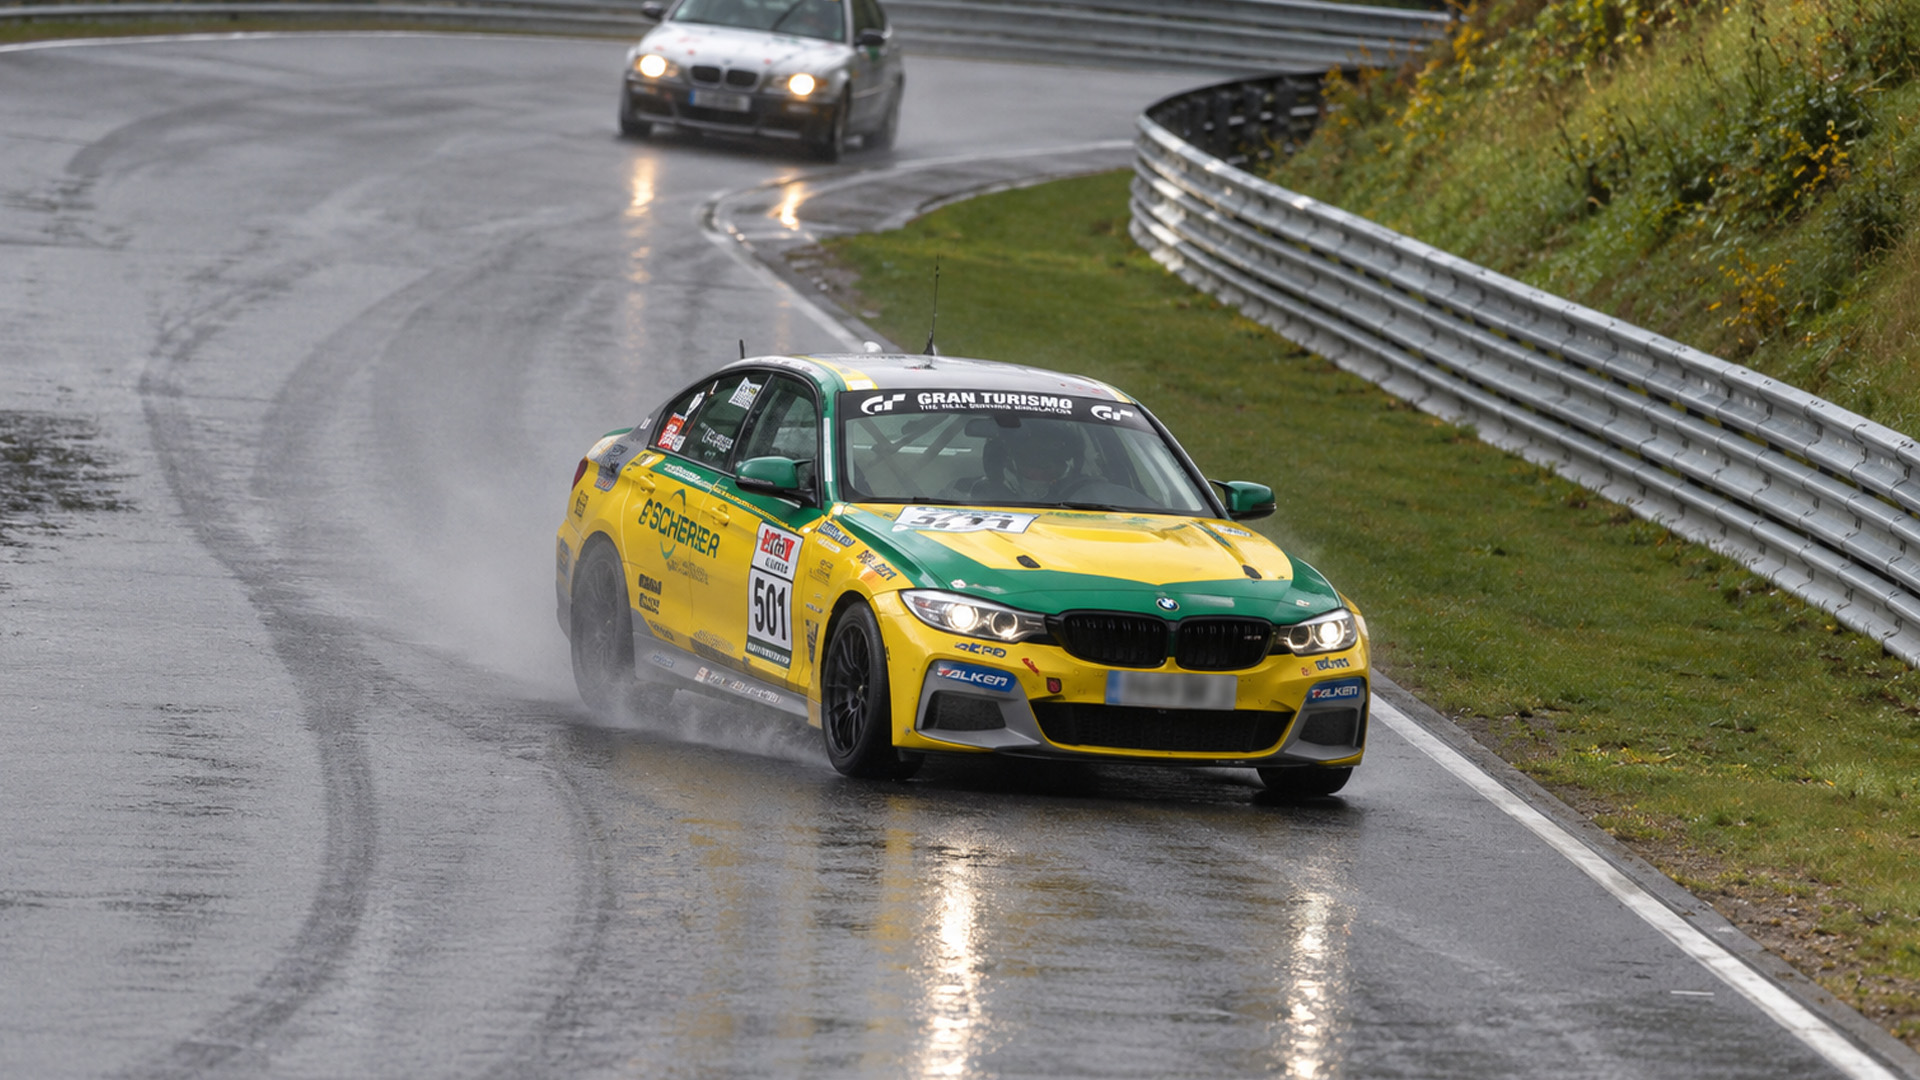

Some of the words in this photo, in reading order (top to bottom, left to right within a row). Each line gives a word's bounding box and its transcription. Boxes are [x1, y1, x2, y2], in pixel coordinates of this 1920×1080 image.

[917, 392, 975, 404] GRAN
[980, 392, 1073, 409] TURISMO
[754, 576, 787, 641] 501
